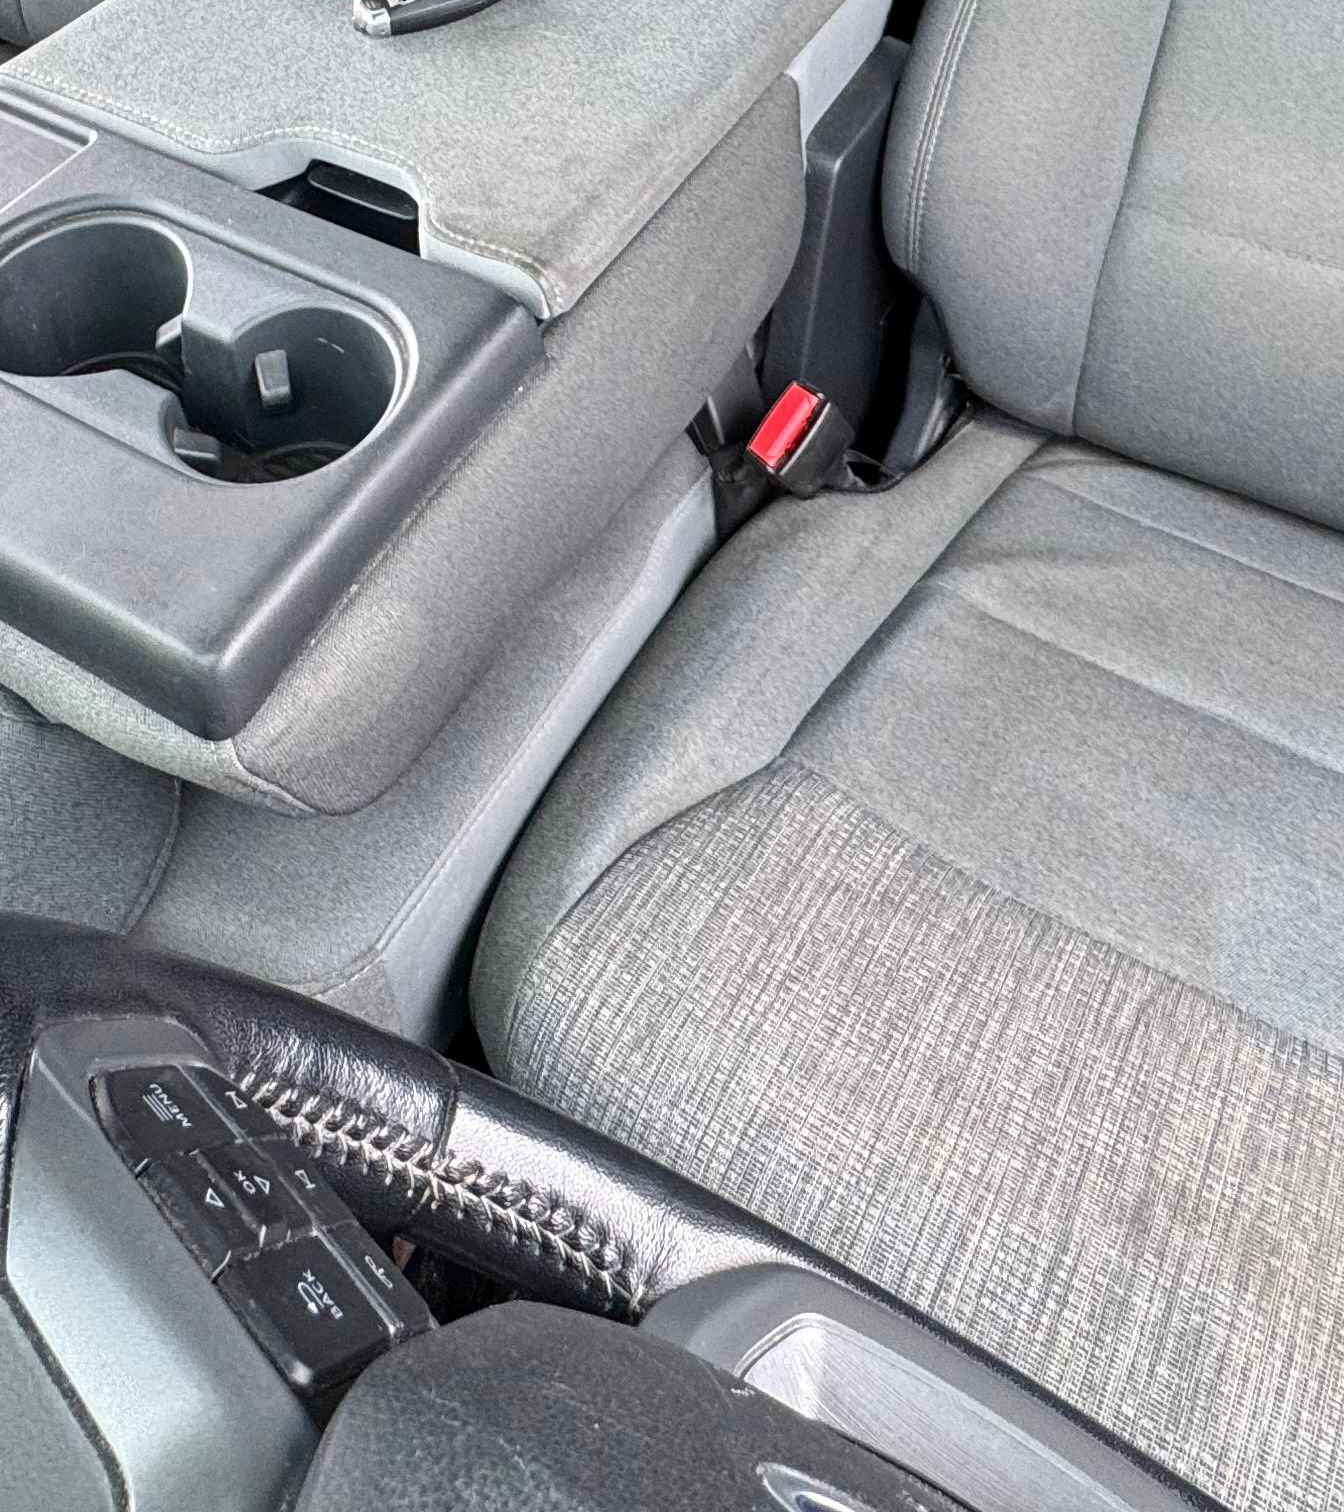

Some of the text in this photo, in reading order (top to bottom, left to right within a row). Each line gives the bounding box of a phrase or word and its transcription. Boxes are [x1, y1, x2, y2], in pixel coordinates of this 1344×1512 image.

[149, 1083, 193, 1129] MENU
[233, 1169, 256, 1195] OK
[302, 1268, 345, 1320] BACK
